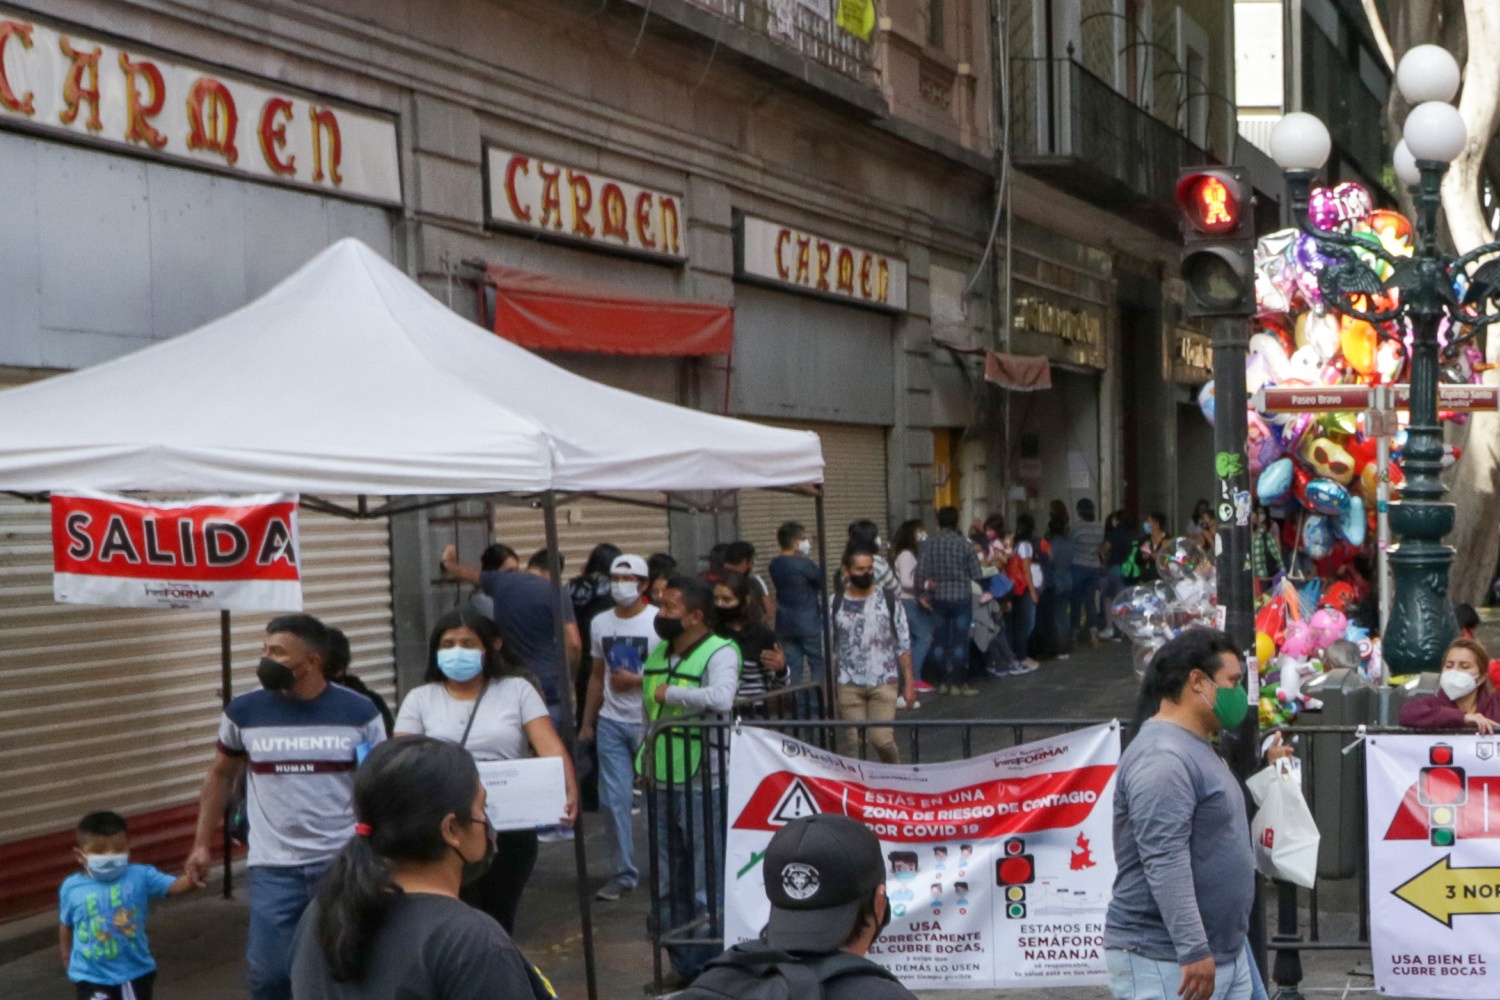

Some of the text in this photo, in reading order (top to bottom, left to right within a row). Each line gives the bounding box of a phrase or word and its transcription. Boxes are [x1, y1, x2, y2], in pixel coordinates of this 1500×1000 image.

[0, 20, 343, 186] CARMEN
[504, 156, 680, 254] CARMEN
[774, 228, 889, 303] CARMEN
[1292, 395, 1341, 405] Paseo Bravo
[66, 511, 298, 567] SALIDA
[252, 735, 352, 752] AUTHENTIC
[275, 764, 314, 773] HUMAN
[950, 788, 985, 804] UNA
[863, 789, 1098, 821] ZONA DE RIESGO DE CONTAGIO
[903, 823, 957, 837] COVID
[961, 824, 980, 835] 19
[1445, 885, 1456, 899] 3
[909, 921, 942, 932] USA
[1020, 923, 1102, 935] ESTAMOS EN
[873, 931, 982, 944] ORRECTAMENTE
[1018, 934, 1104, 948] SEMÁFORO
[887, 944, 932, 954] CUBRE
[1024, 949, 1099, 960] NARANJA
[1391, 954, 1486, 965] USA BIEN EL
[895, 962, 931, 972] DEMÁS
[951, 963, 980, 972] USEN
[1392, 966, 1486, 976] CUBRE BOCAS
